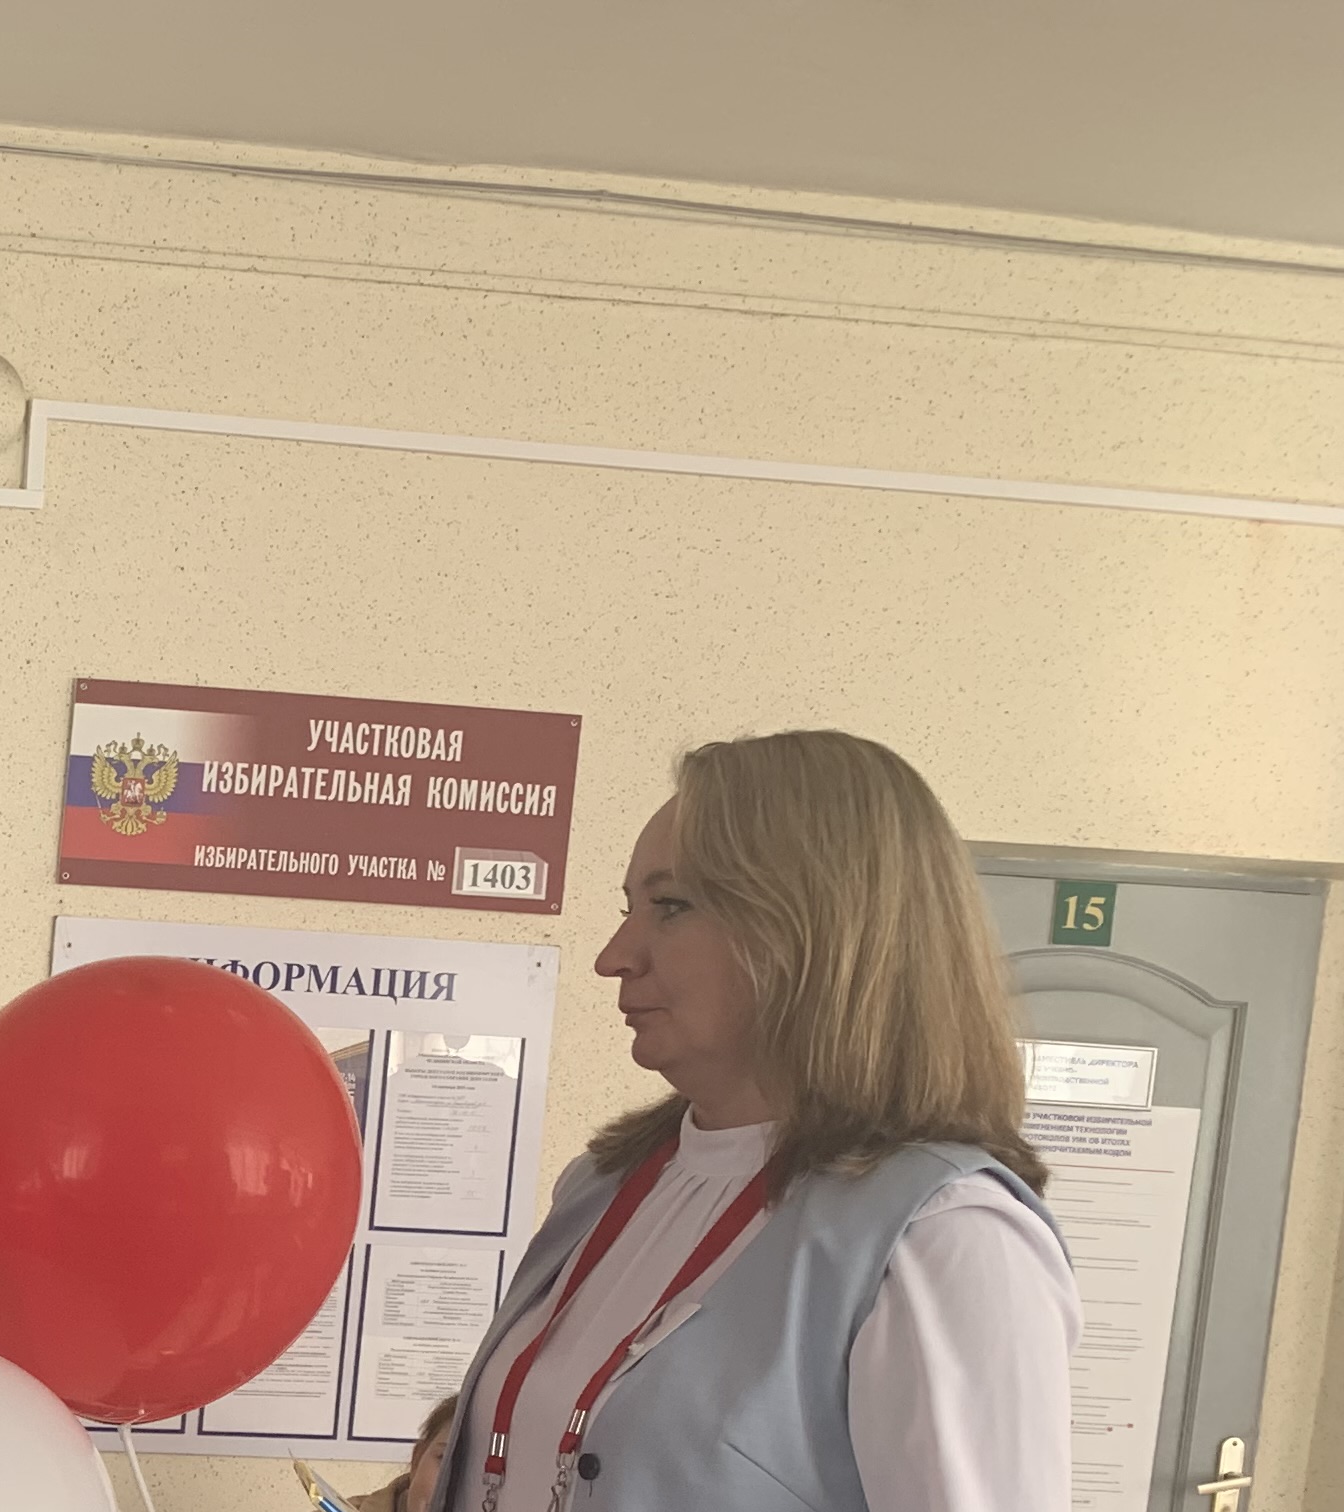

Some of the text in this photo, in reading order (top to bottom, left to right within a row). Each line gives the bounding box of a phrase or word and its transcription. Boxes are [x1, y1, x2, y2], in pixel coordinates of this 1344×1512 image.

[307, 718, 464, 763] УЧАСТКОВАЯ
[201, 760, 558, 818] ИЗБИРАТЕЛЬНАЯ КОМИССИЯ
[193, 844, 533, 891] ИЗБИРАТЕЛЬНОГО УЧАСТКА № 1403
[1061, 895, 1106, 931] 15
[189, 957, 459, 1005] ФОРМАЦИЯ
